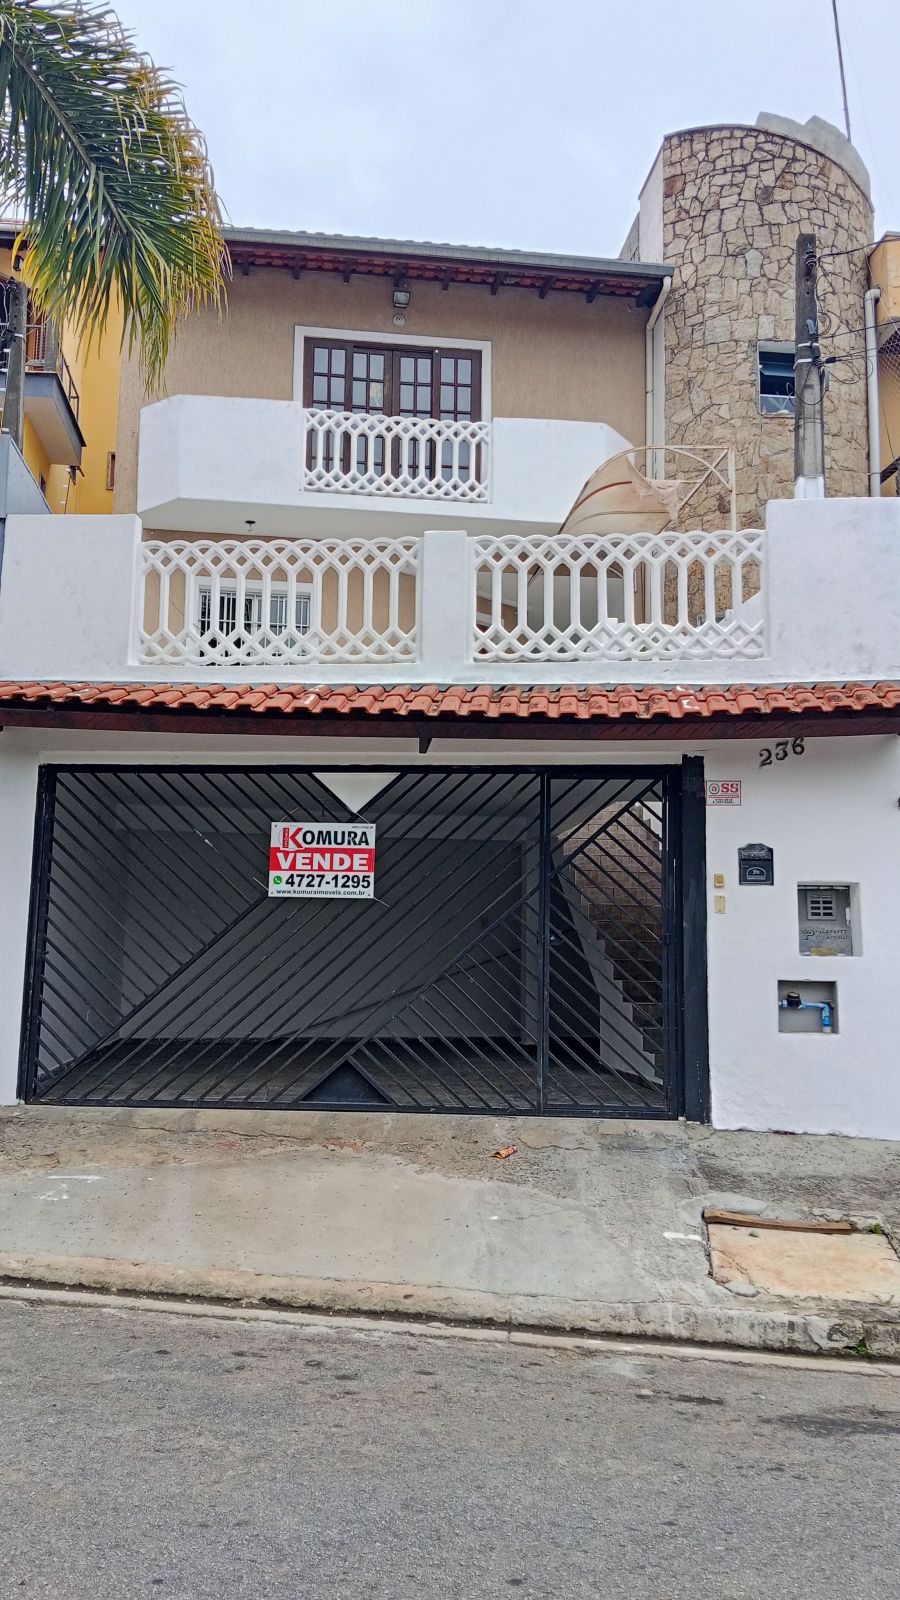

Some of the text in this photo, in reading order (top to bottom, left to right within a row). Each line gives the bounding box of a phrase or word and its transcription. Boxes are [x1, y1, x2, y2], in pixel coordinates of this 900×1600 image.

[759, 736, 805, 767] 236
[282, 827, 369, 848] KOMURA
[276, 852, 369, 871] VENDE
[285, 874, 371, 889] 4727-1295
